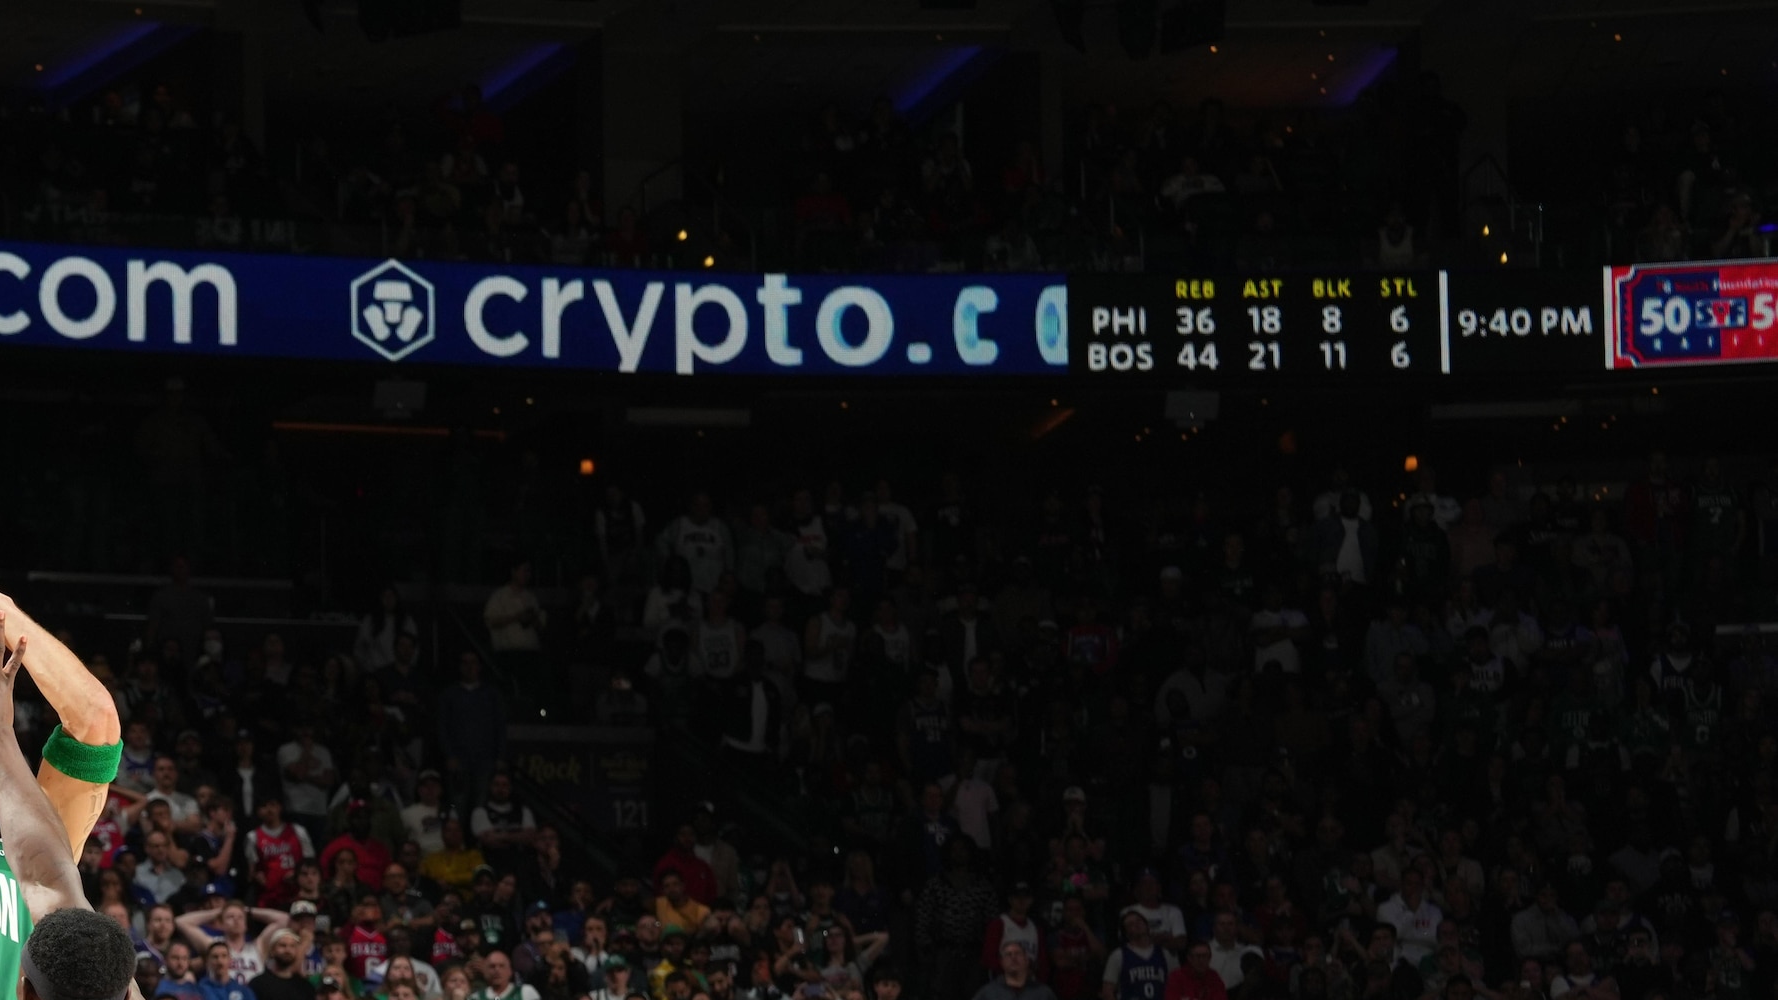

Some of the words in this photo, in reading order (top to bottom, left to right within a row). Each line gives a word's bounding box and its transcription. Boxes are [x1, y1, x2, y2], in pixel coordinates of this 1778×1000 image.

[1175, 279, 1216, 299] REB
[1243, 279, 1283, 298] AST
[1312, 279, 1352, 298] BLK
[1380, 278, 1419, 298] STL
[1091, 306, 1147, 335] PHI
[1175, 306, 1216, 335] 36
[1247, 305, 1282, 335] 18
[1321, 304, 1343, 334] 8
[1389, 304, 1411, 334] 6
[1457, 307, 1533, 338] 9:40
[1540, 305, 1593, 336] PM
[1639, 295, 1691, 336] 50
[1752, 292, 1778, 330] 5
[1087, 342, 1154, 371] BOS
[1176, 341, 1220, 371] 44
[1247, 341, 1281, 370] 21
[1320, 340, 1347, 370] 11
[1390, 340, 1411, 370] 6
